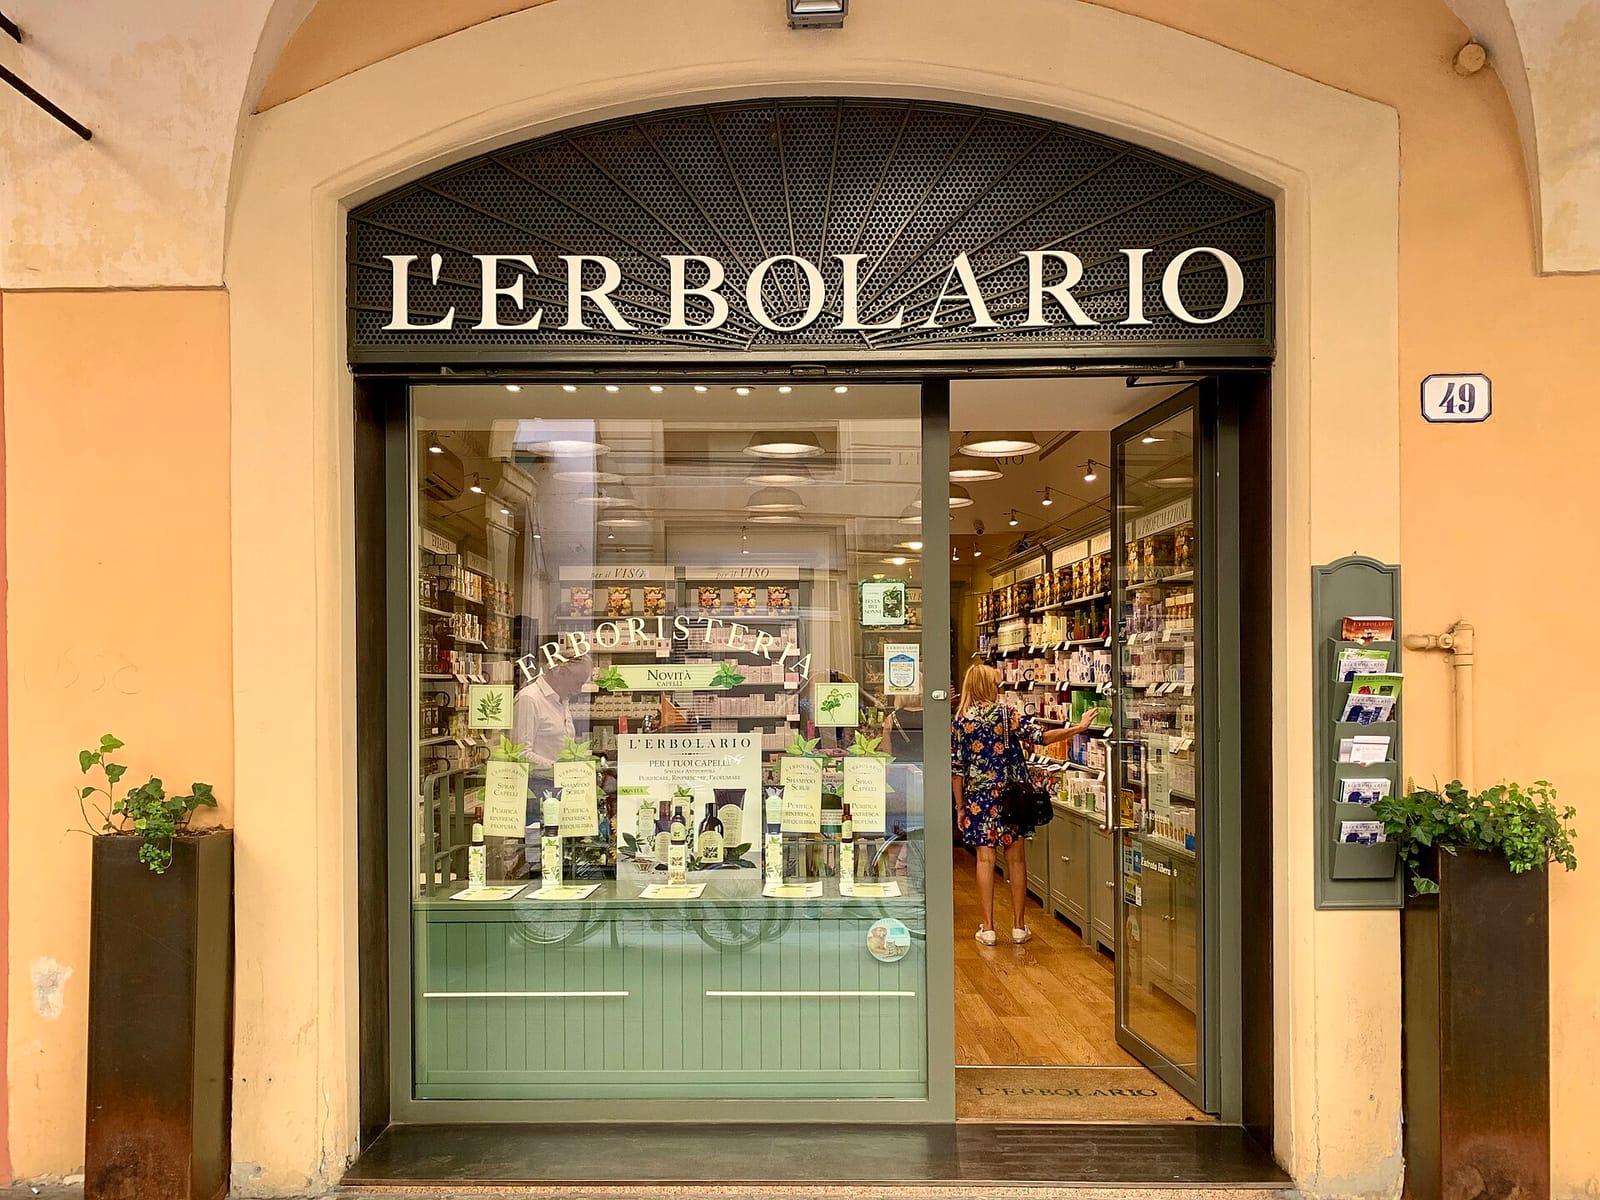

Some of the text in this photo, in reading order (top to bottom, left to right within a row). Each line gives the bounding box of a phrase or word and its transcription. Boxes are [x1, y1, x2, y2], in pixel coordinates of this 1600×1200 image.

[381, 246, 1246, 333] L'ERBOLARIO
[1438, 382, 1476, 414] 49
[613, 568, 644, 579] VISO
[740, 567, 770, 578] VISO
[516, 616, 812, 682] ERBORISTERIA
[629, 738, 751, 749] L'ERBOLARIO
[975, 1086, 1158, 1097] L'ERBOLARIO
